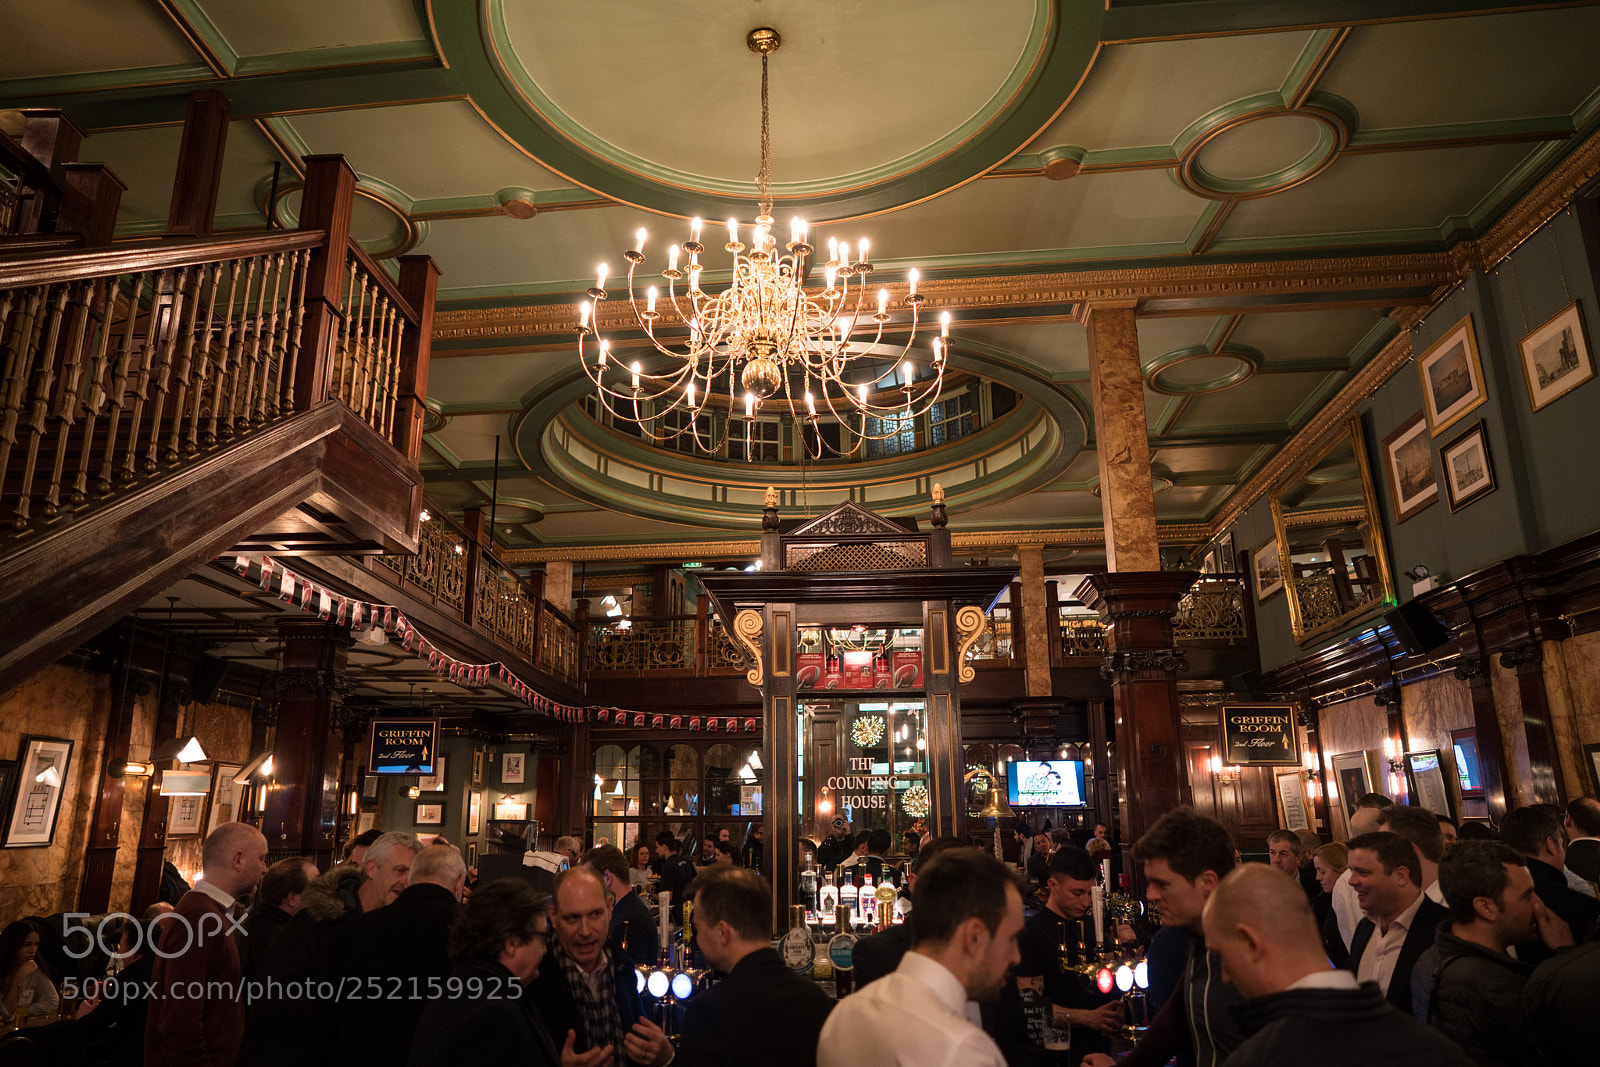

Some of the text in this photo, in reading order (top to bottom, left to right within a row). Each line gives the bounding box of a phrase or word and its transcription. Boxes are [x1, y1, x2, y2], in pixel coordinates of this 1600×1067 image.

[1230, 716, 1288, 724] GRIFFIN
[1248, 738, 1275, 748] Floor
[390, 750, 415, 758] Floor
[850, 758, 875, 770] THE
[827, 776, 898, 790] COUNTING
[841, 796, 886, 809] HOUSE
